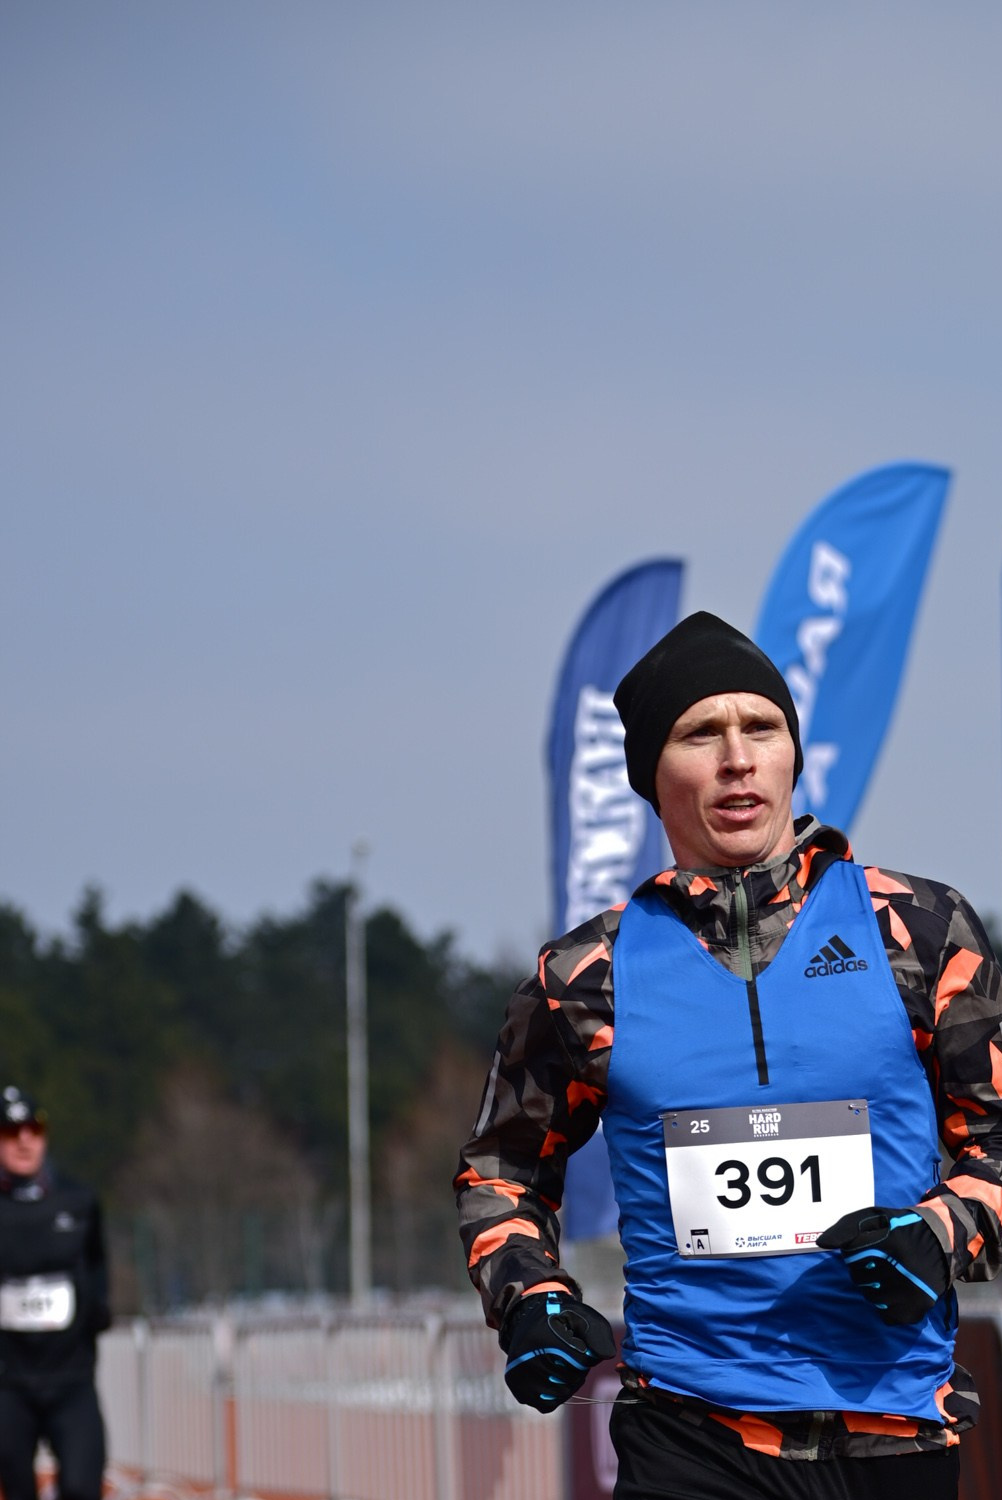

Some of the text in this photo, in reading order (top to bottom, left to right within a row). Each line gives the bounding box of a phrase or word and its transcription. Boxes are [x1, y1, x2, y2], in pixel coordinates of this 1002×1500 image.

[803, 958, 868, 978] adidas
[748, 1112, 782, 1125] HARD
[689, 1119, 711, 1134] 25
[753, 1123, 779, 1135] RUN
[714, 1154, 822, 1209] 391
[747, 1234, 783, 1242] ВЫСШАЯ
